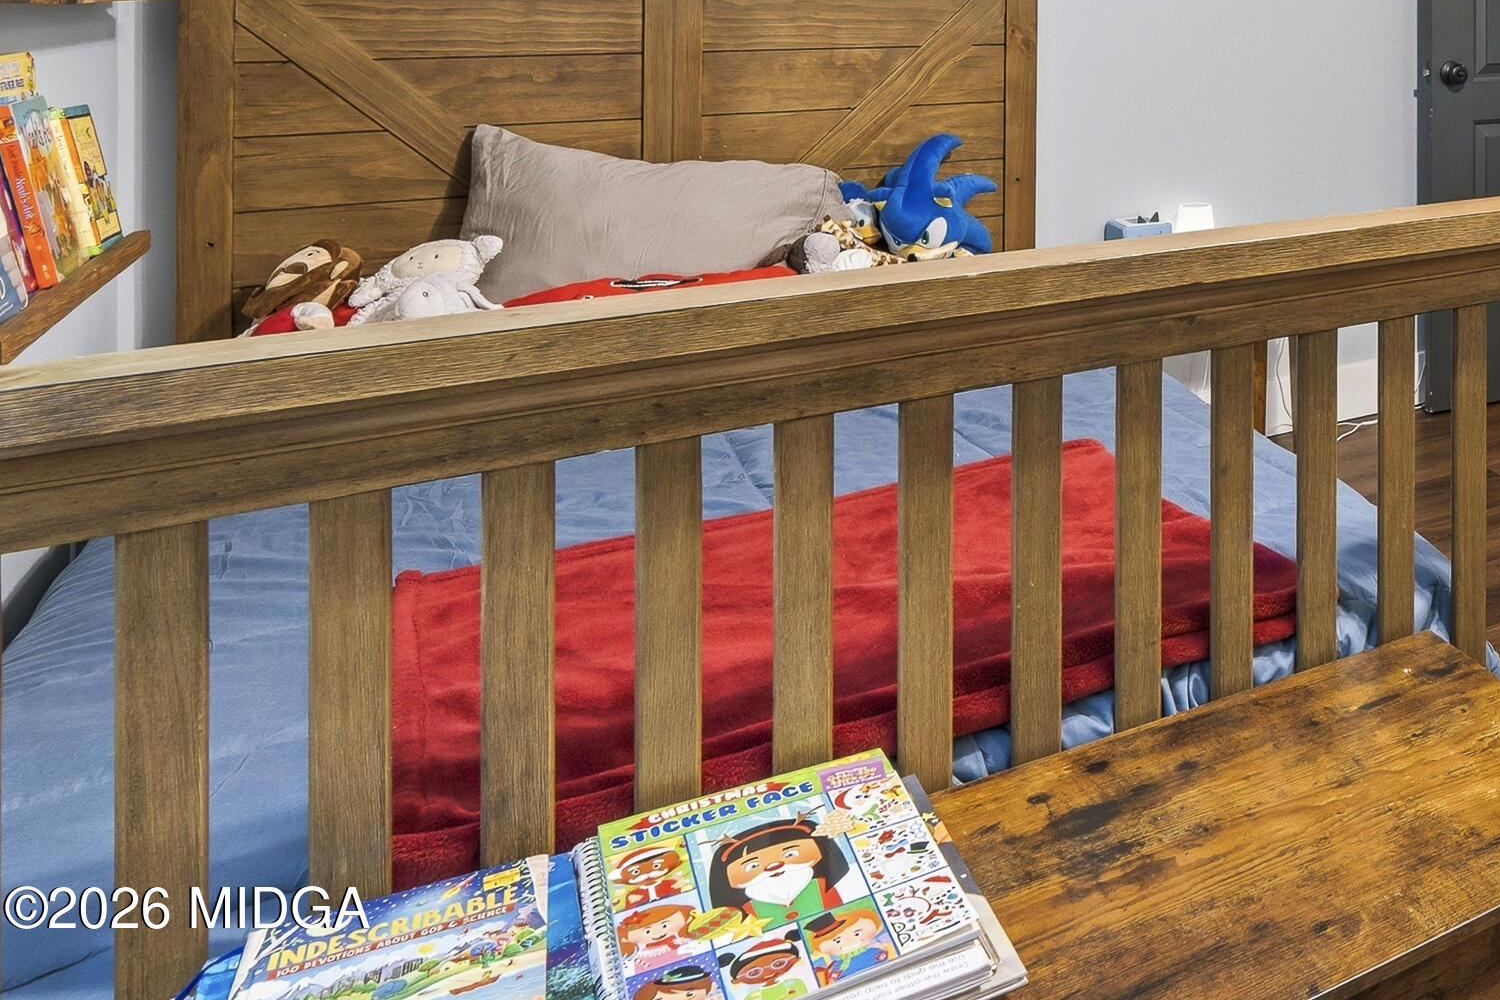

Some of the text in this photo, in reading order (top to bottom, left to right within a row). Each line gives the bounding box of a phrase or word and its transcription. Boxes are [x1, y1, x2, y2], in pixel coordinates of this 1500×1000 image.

[609, 780, 814, 849] STICKER FACE
[647, 783, 770, 825] CHRISTMAS
[267, 885, 518, 971] INDESCRIBABLE
[276, 964, 301, 978] 100
[304, 944, 372, 970] DEVOTIONS
[376, 933, 416, 949] ABOUT
[420, 925, 445, 936] GOD
[462, 907, 509, 924] SCIENCE
